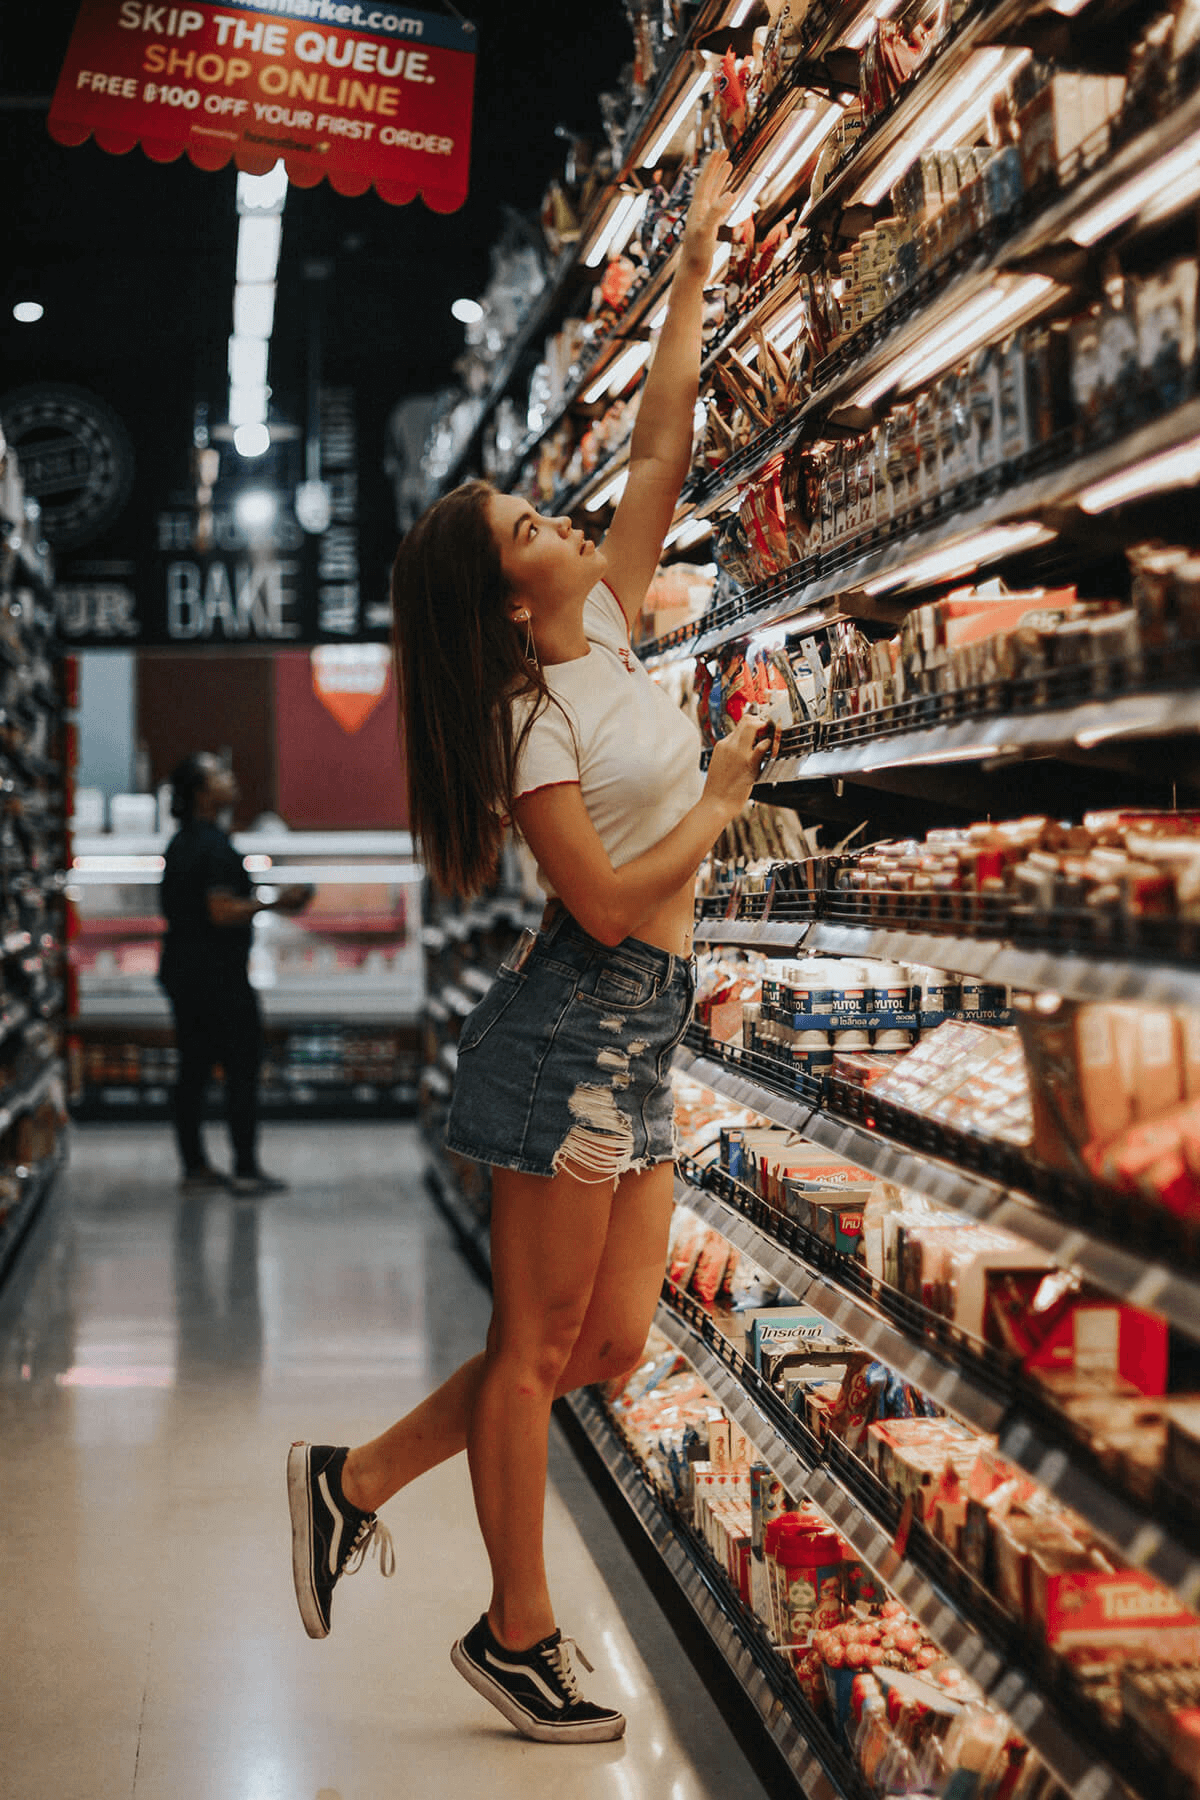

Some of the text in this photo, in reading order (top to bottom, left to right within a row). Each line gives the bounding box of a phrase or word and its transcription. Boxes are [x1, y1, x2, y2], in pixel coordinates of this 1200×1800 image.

[119, 1, 435, 84] SKIP THE QUEUE.
[143, 45, 402, 116] SHOP ONLINE
[77, 70, 137, 99] FREE
[204, 94, 248, 117] OFF
[253, 103, 314, 129] YOUR
[316, 114, 375, 141] FIRST
[379, 128, 455, 156] ORDER
[167, 560, 302, 640] BAKE
[966, 1011, 997, 1019] XYLITOL
